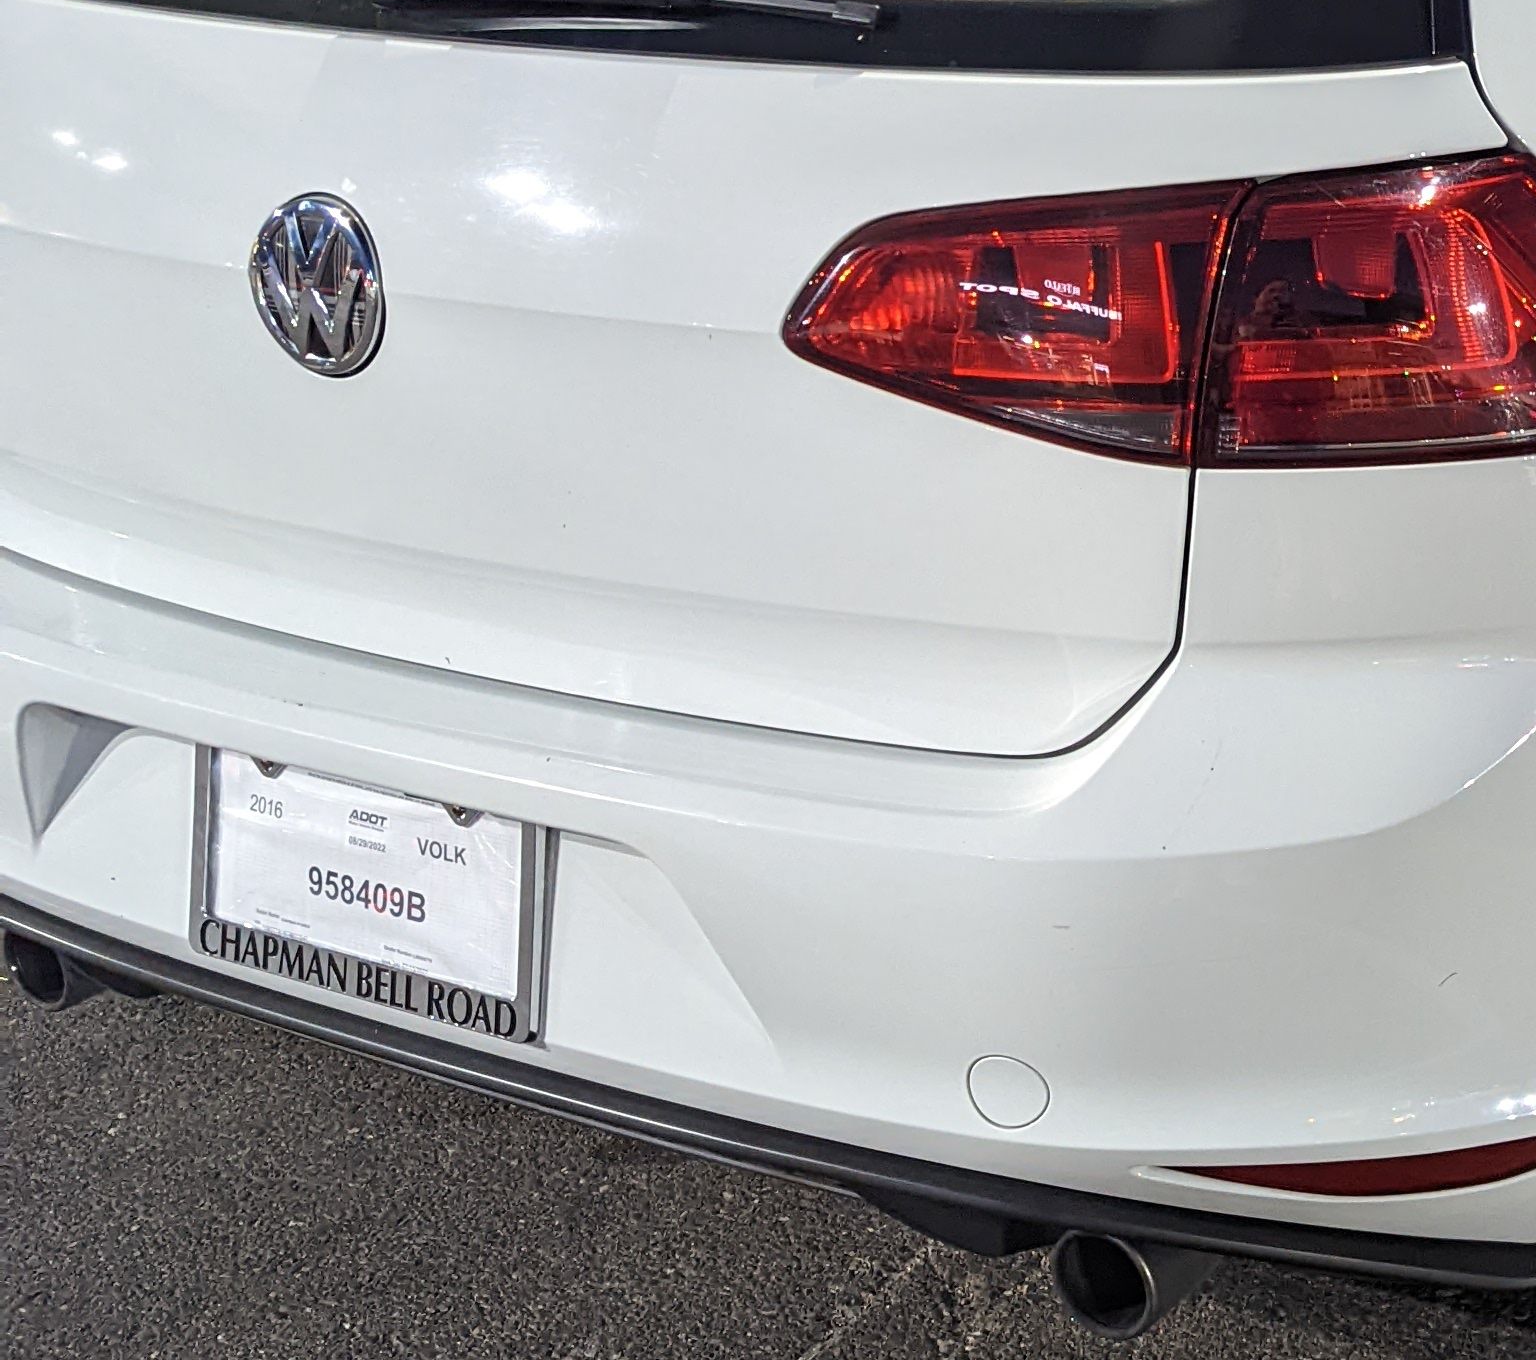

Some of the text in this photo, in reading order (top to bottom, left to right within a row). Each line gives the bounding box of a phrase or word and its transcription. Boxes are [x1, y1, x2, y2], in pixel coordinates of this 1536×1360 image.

[252, 196, 380, 370] VW
[250, 793, 283, 819] 2016
[349, 809, 388, 828] ADOT
[416, 836, 467, 866] VOLK
[308, 866, 426, 923] 958409B
[200, 918, 517, 1037] CHAPMAN BELL ROAD
